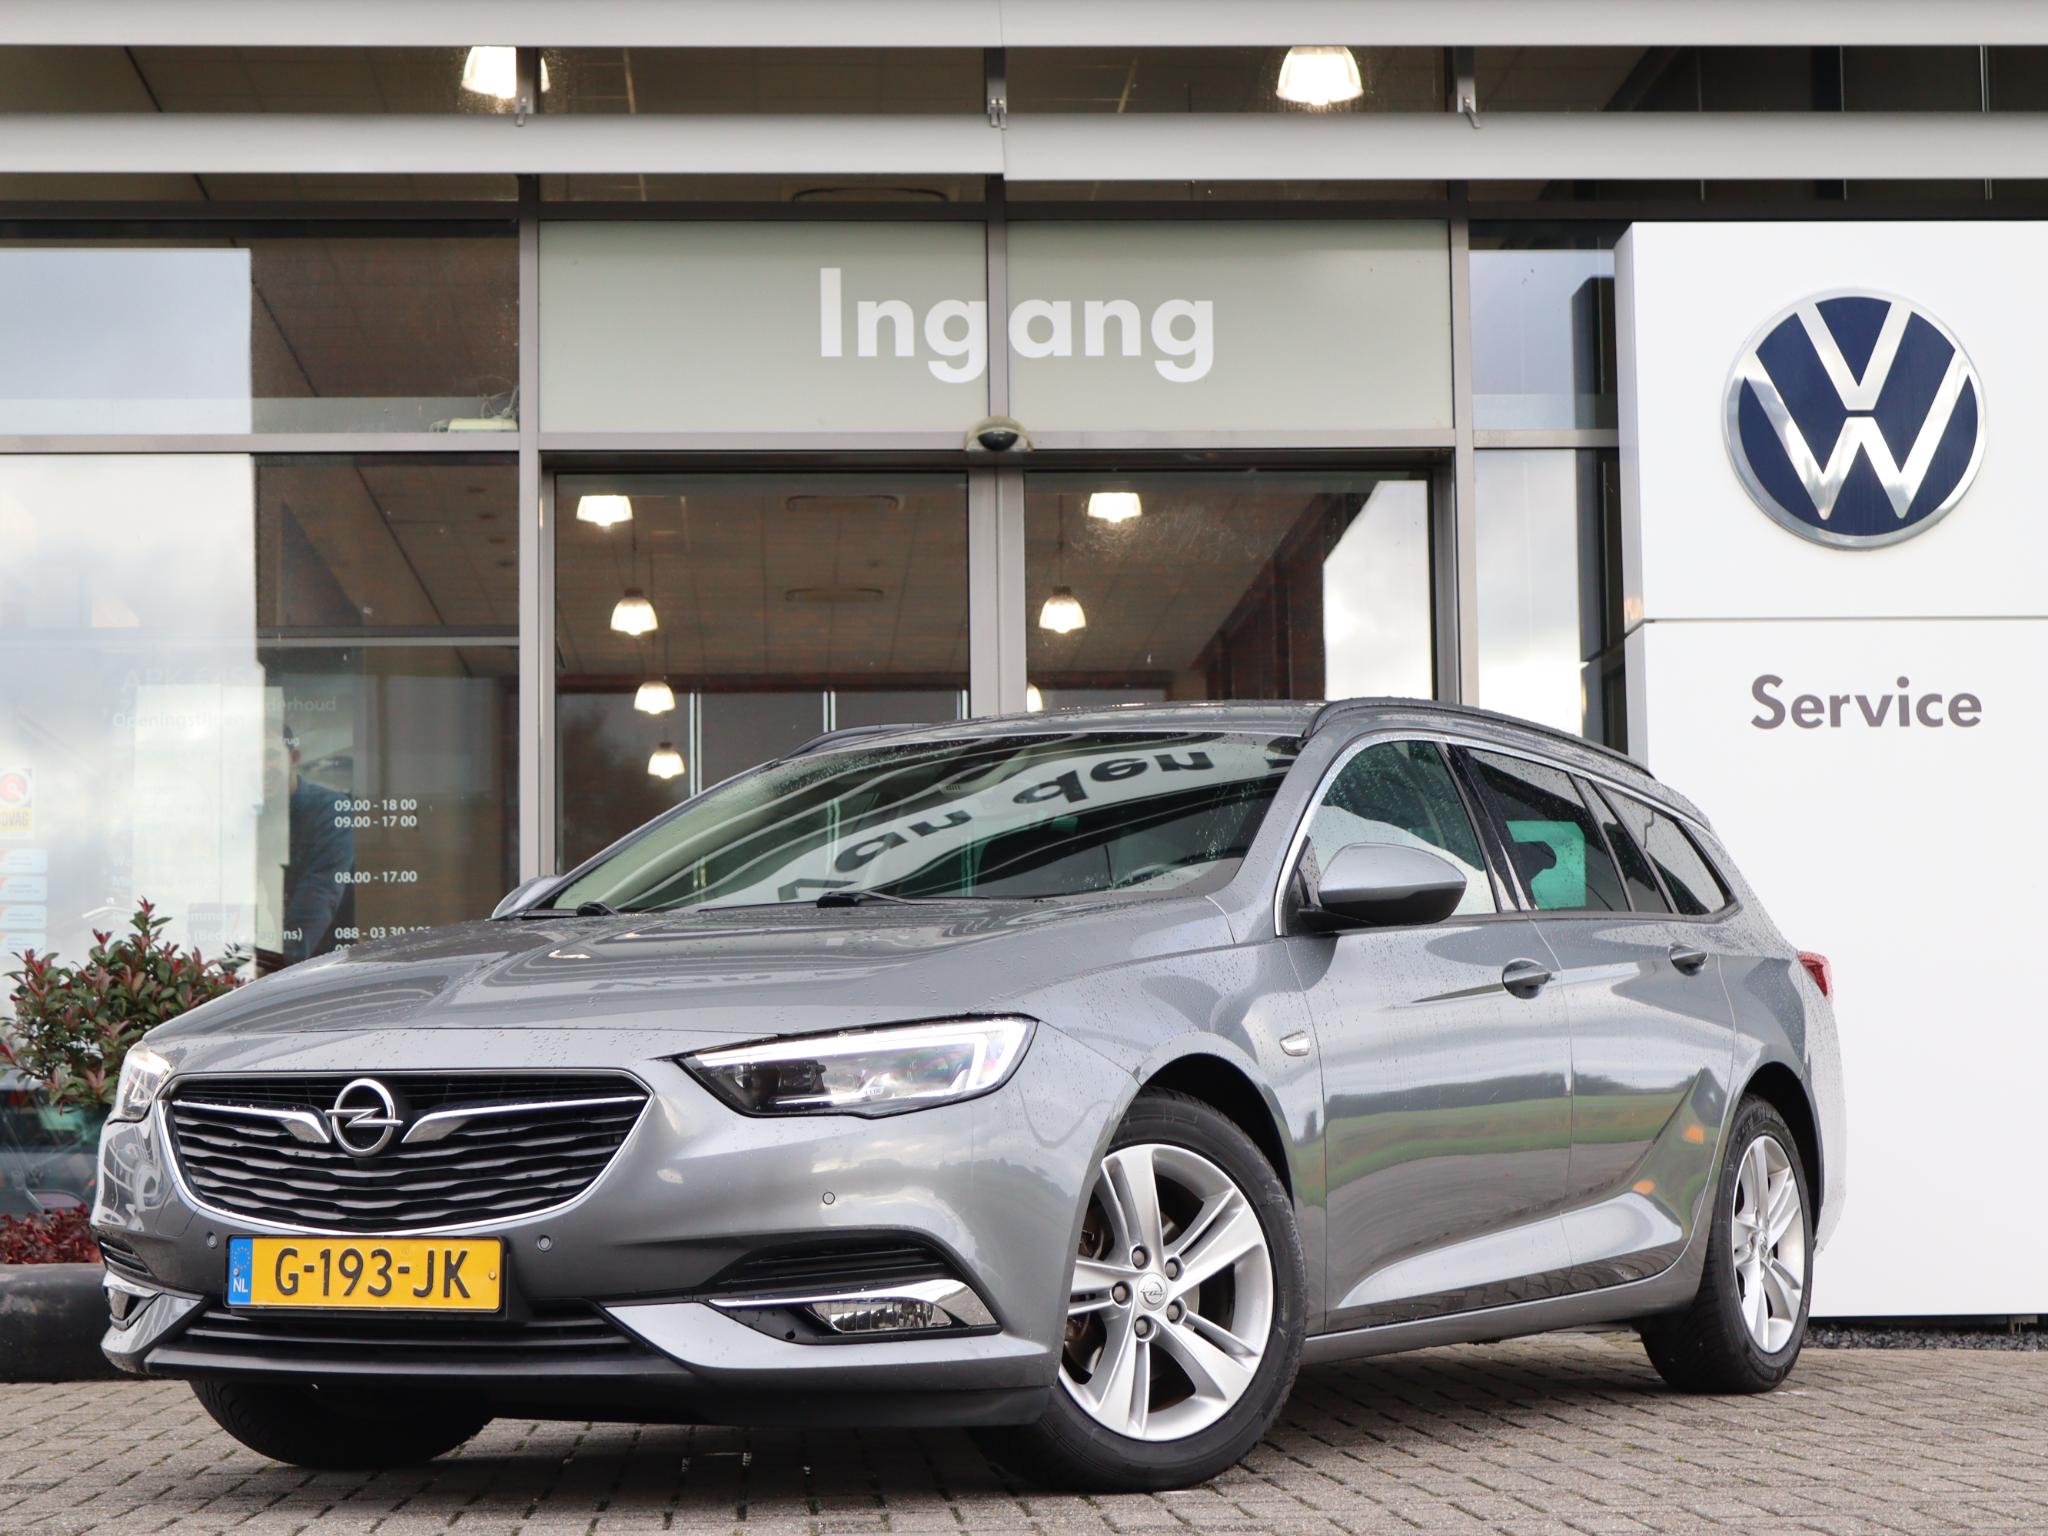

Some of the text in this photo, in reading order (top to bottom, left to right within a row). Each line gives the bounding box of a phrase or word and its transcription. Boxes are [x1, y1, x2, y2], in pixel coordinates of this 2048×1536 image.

[820, 267, 1214, 384] Ingang
[1750, 674, 1982, 730] Service
[334, 800, 371, 812] 09.00
[382, 799, 417, 811] 1800
[0, 811, 29, 827] OVAG
[334, 816, 371, 828] 09.00
[382, 815, 417, 827] 1700
[334, 872, 371, 884] 08.00
[382, 871, 417, 883] 17.00
[334, 927, 360, 939] 088
[369, 927, 386, 938] 03
[274, 1247, 471, 1298] G-193-JK
[232, 1278, 249, 1293] NL
